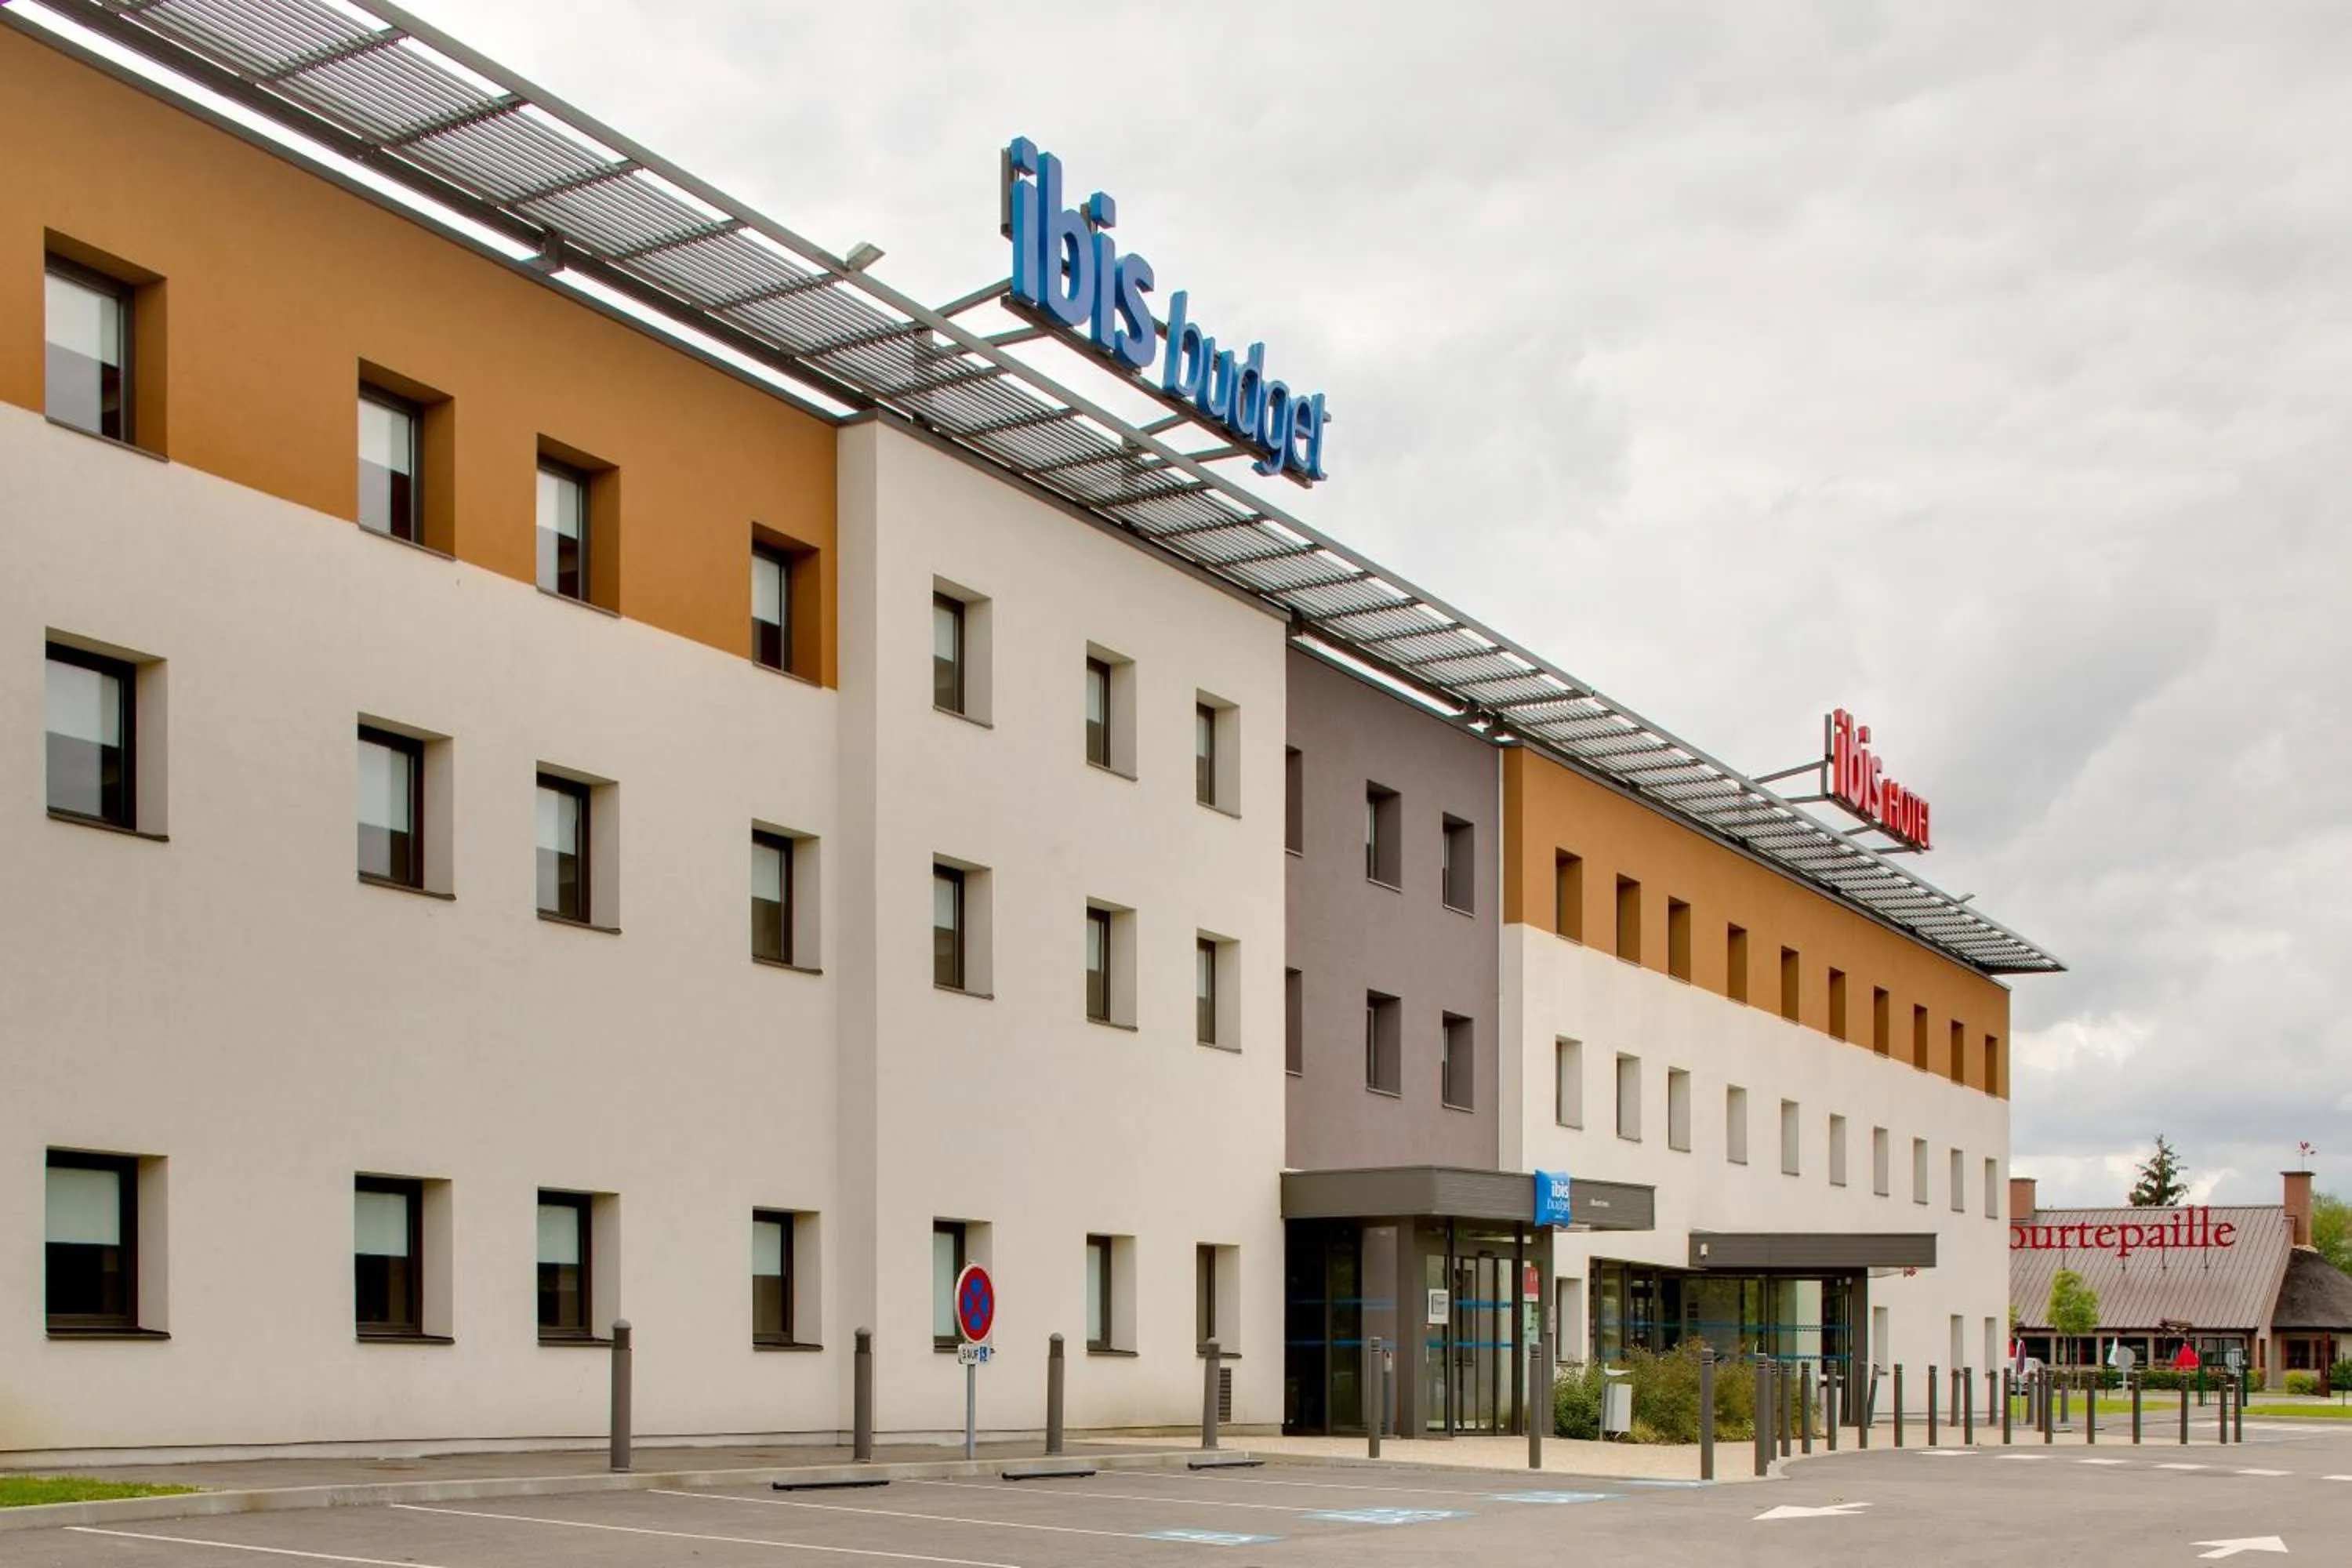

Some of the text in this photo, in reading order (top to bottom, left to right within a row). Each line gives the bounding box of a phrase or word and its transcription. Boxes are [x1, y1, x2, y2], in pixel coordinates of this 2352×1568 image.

[1011, 136, 1332, 481] ibis budget
[1833, 708, 1883, 824] ibis
[1551, 1180, 1569, 1199] ibis
[2009, 1205, 2236, 1258] ourtepaille
